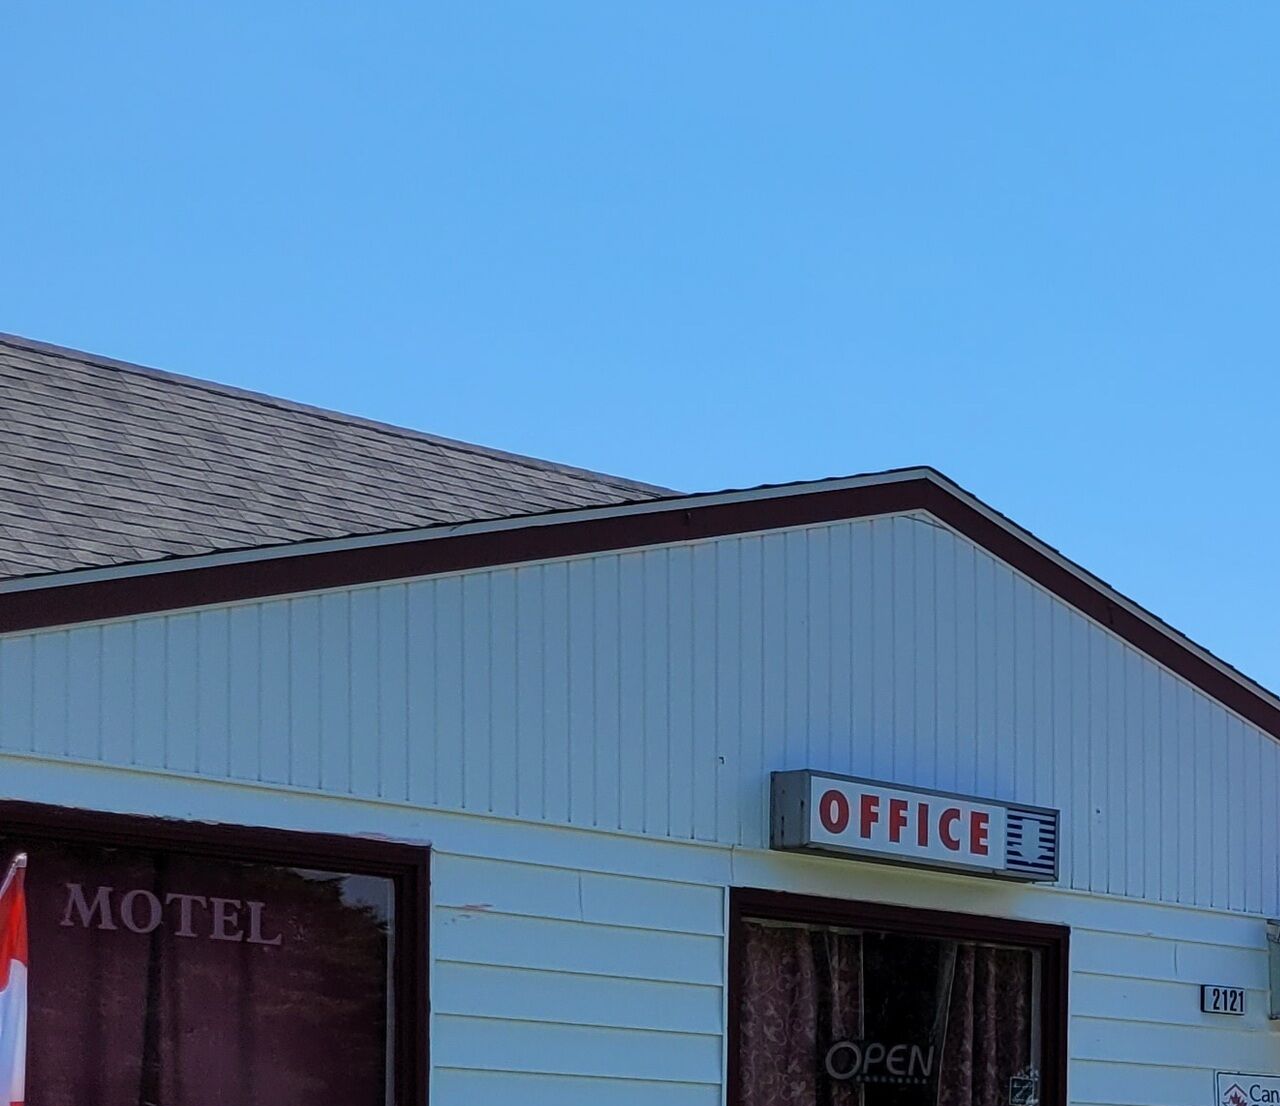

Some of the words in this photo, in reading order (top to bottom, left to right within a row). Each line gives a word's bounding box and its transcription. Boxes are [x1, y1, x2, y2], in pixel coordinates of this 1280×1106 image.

[818, 789, 989, 856] OFFICE
[60, 882, 282, 946] MOTEL
[1212, 988, 1244, 1013] 2121
[825, 1041, 935, 1080] OPEN
